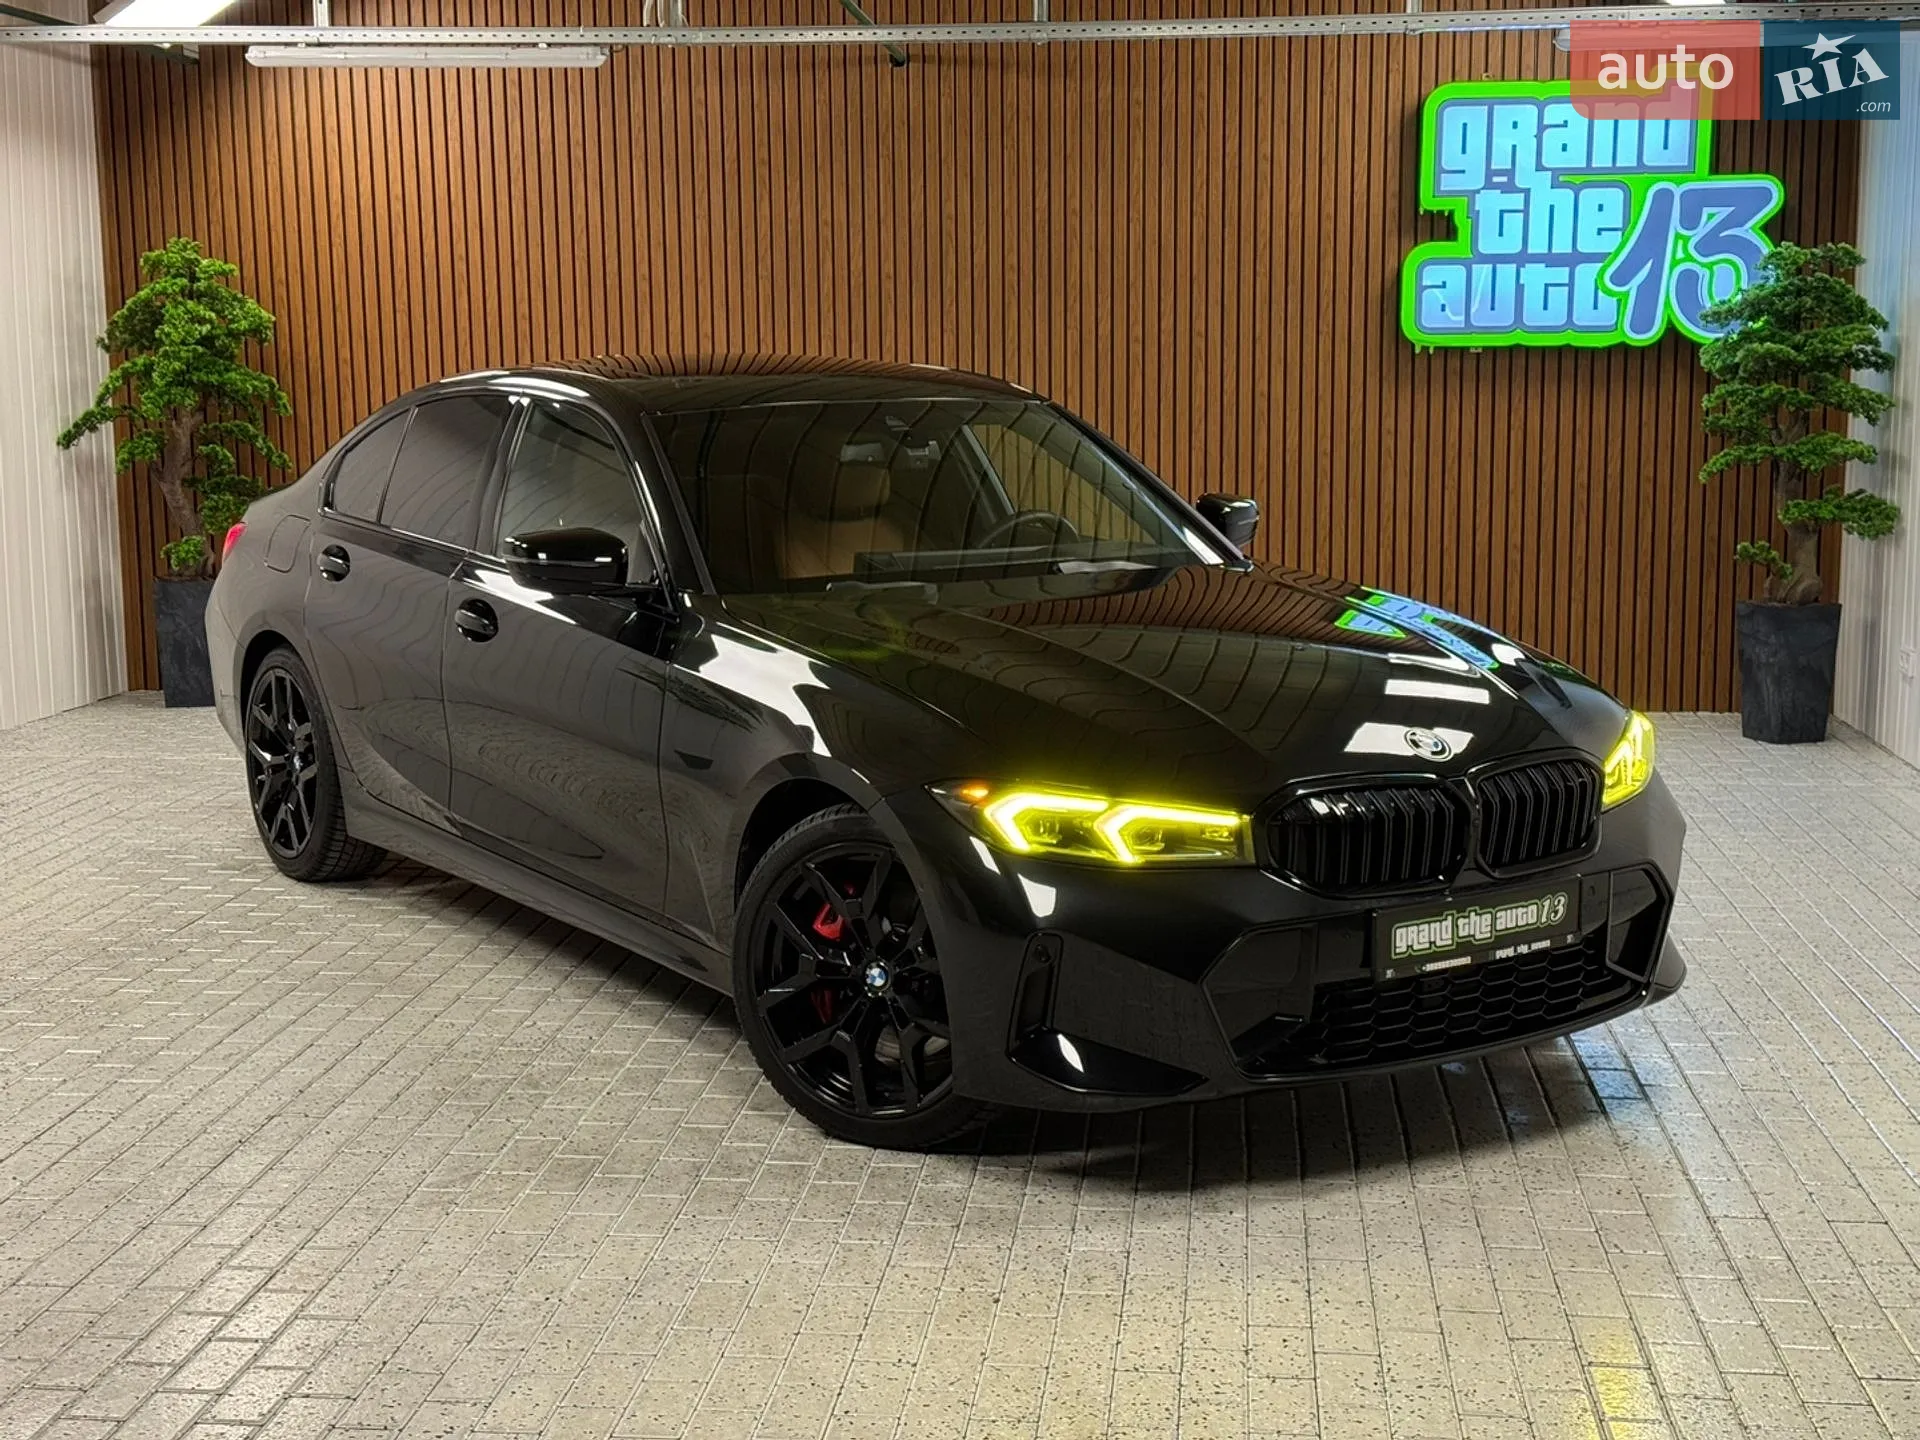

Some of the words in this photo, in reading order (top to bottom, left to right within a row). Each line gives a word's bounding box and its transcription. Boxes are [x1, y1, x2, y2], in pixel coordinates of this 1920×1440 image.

[1475, 171, 1625, 255] the
[1421, 263, 1619, 329] auto
[1603, 181, 1778, 340] 13
[1457, 911, 1492, 940] the
[1495, 904, 1538, 931] auto
[1541, 895, 1566, 924] 13
